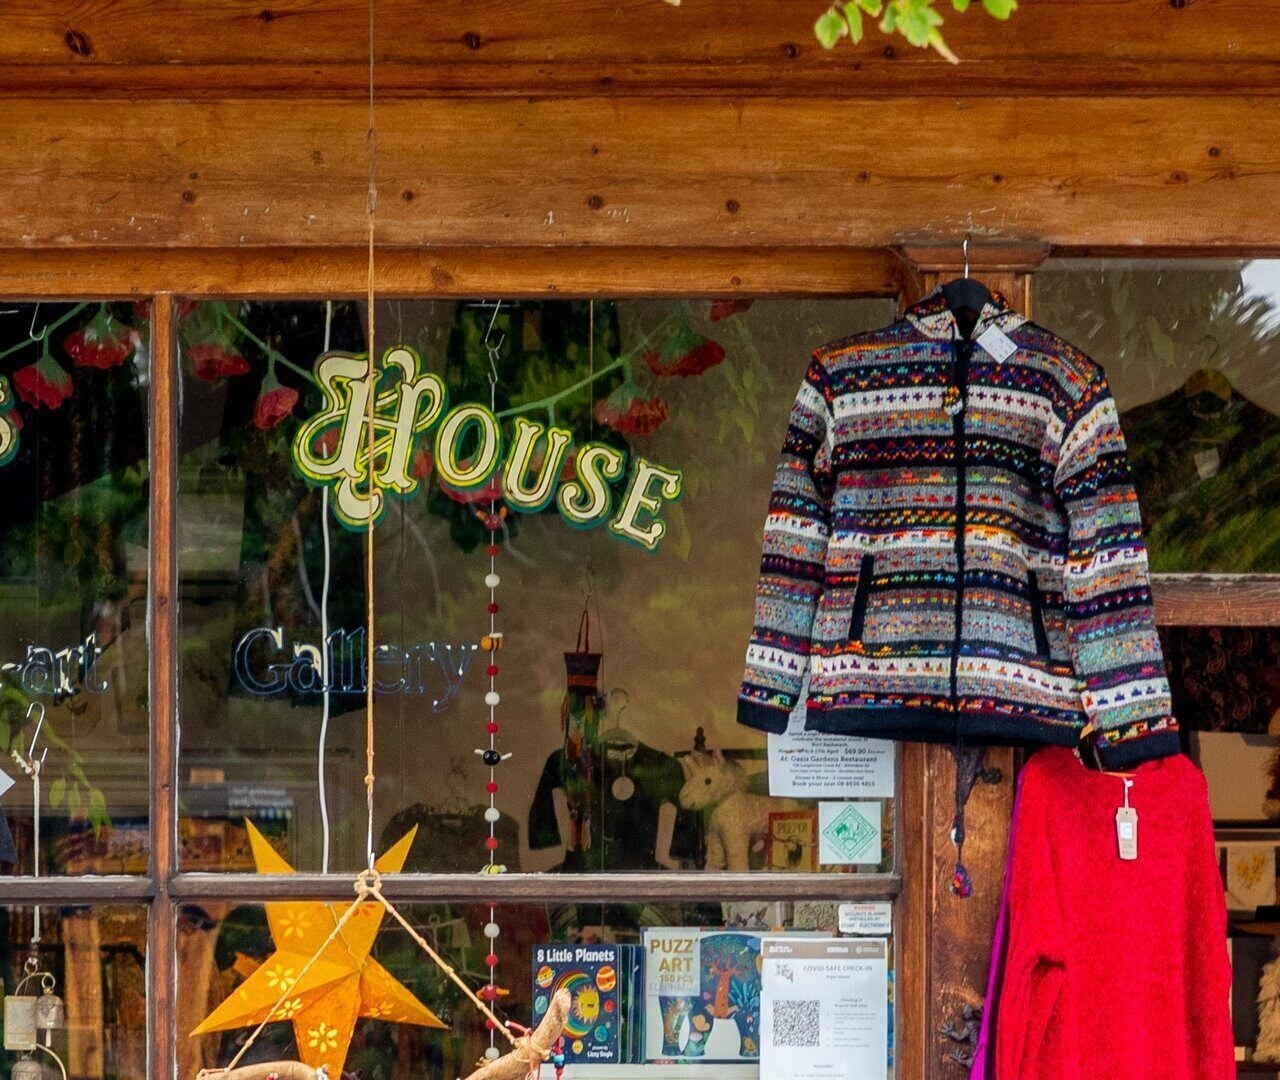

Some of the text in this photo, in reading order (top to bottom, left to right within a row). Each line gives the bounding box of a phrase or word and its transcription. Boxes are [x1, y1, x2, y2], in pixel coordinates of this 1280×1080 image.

[292, 344, 684, 554] HOUSE
[234, 626, 478, 713] Gallery
[537, 948, 615, 963] 8 Little Planets
[659, 958, 693, 972] ART
